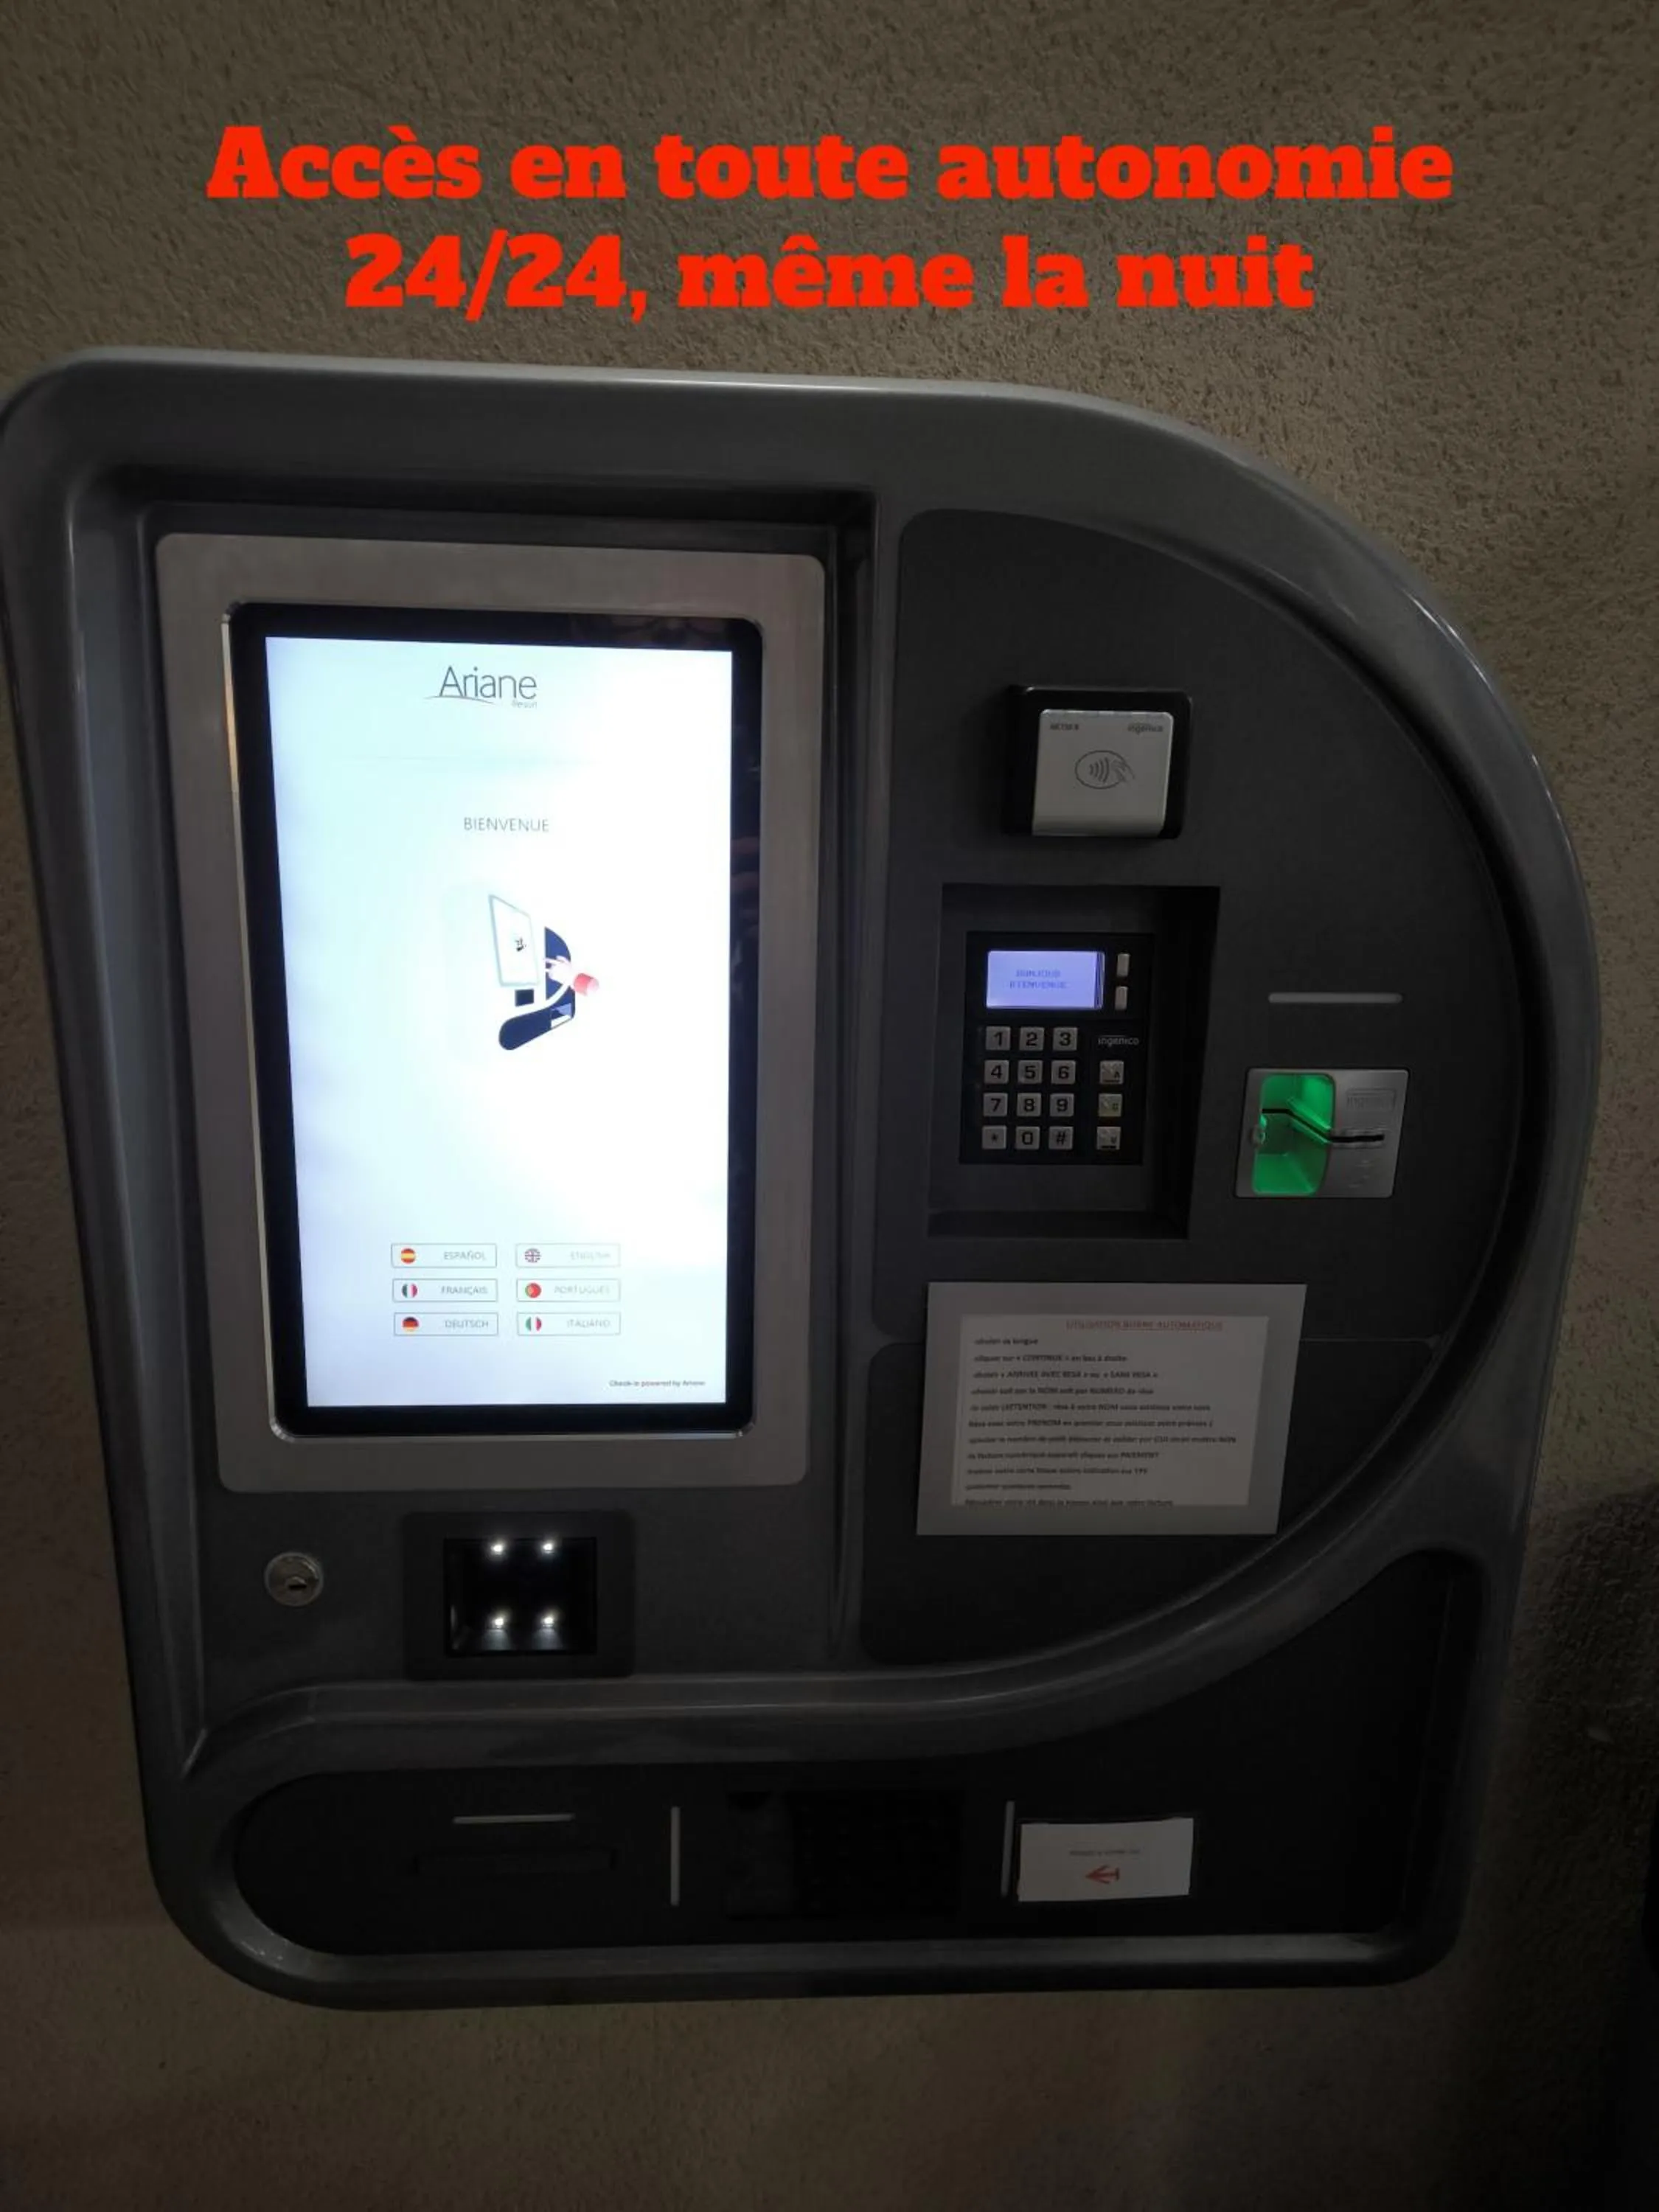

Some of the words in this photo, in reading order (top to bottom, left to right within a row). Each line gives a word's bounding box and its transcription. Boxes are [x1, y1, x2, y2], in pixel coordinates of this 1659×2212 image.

[438, 665, 537, 700] Ariane
[464, 816, 549, 833] BIENVENUE
[993, 1032, 1003, 1046] 1
[1026, 1032, 1037, 1046] 2
[1060, 1032, 1071, 1046] 3
[991, 1065, 1003, 1079] 4
[1025, 1065, 1036, 1079] 5
[1057, 1065, 1069, 1079] 6
[991, 1098, 1001, 1111] 7
[1023, 1098, 1035, 1112] 8
[1057, 1098, 1068, 1112] 9
[443, 1249, 486, 1260] ESPAÑOL
[440, 1285, 487, 1295] FRANÇAIS
[445, 1320, 488, 1329] DEUTSCH
